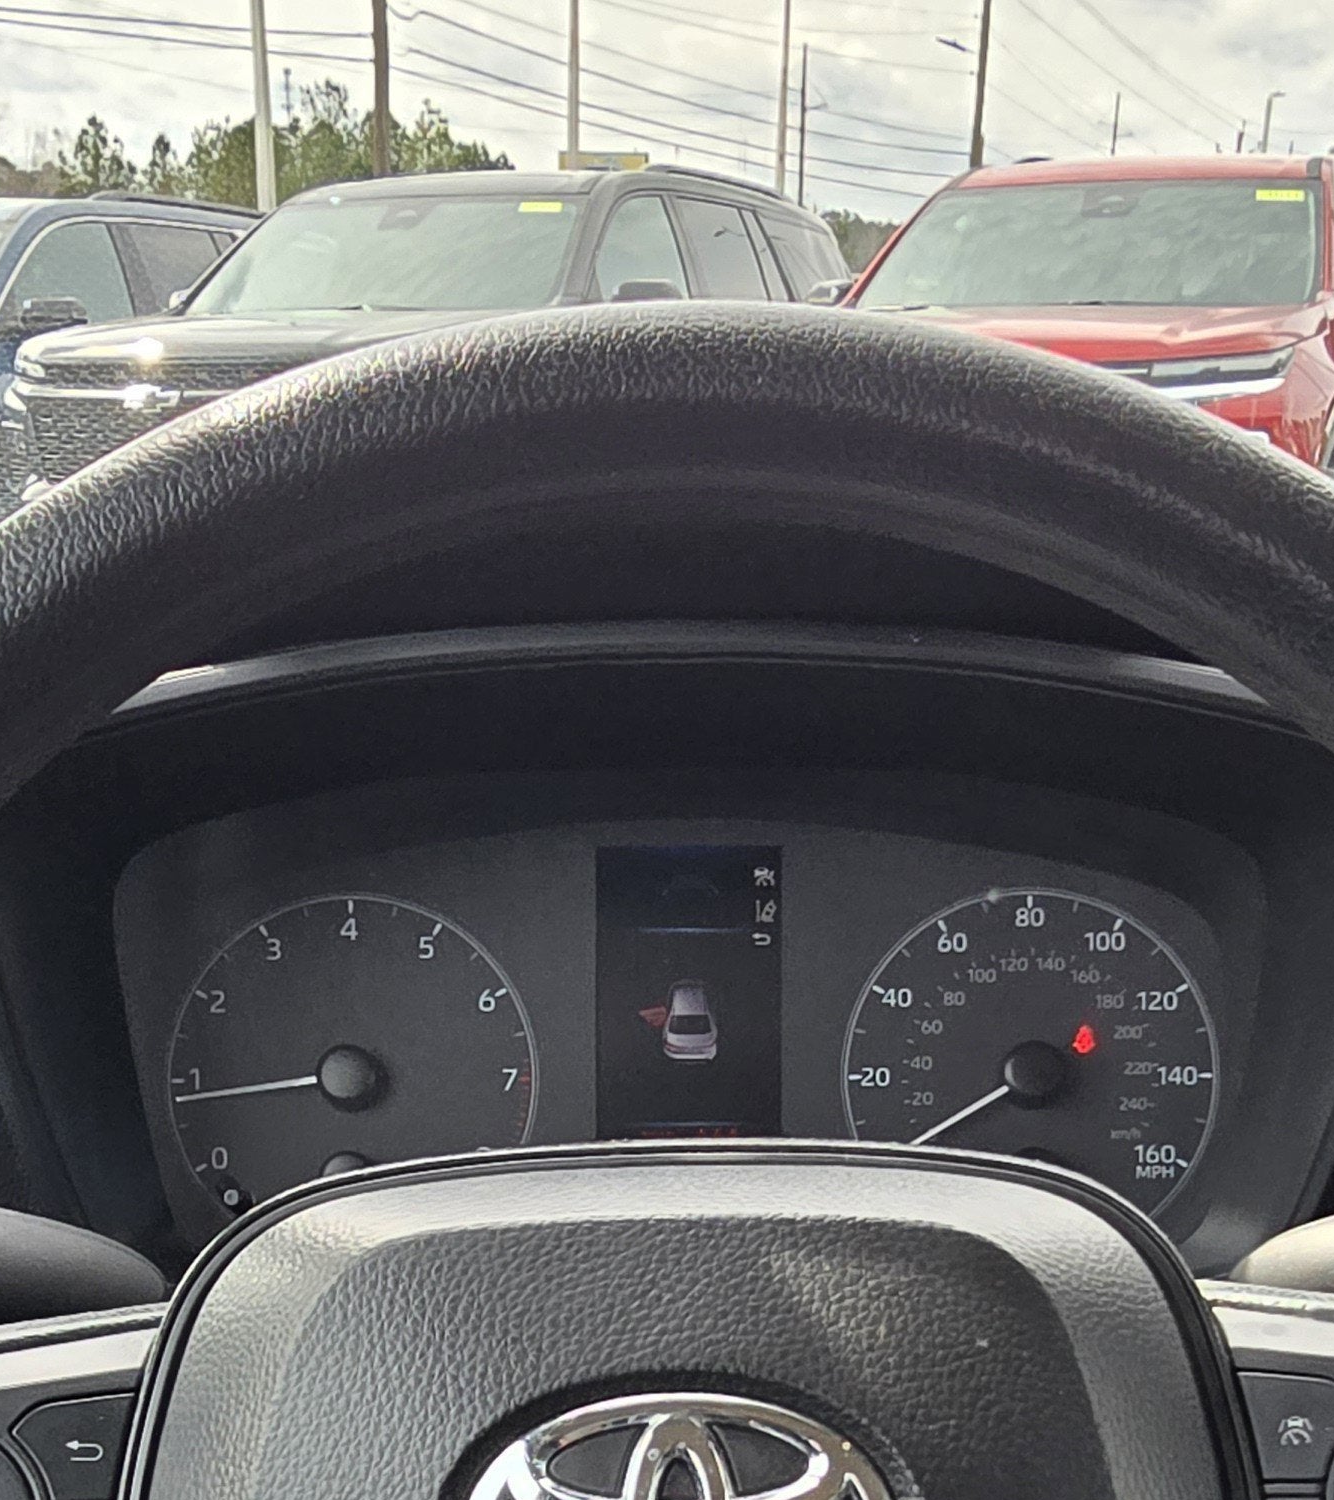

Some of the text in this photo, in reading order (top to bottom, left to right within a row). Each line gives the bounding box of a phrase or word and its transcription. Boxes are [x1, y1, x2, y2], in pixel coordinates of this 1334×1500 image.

[1015, 907, 1045, 927] 80
[340, 917, 358, 941] 4
[266, 938, 282, 961] 3
[418, 936, 435, 959] 5
[937, 932, 968, 953] 60
[1084, 931, 1126, 951] 100
[999, 957, 1029, 972] 120
[1036, 957, 1066, 972] 140
[967, 968, 997, 983] 100
[1070, 969, 1100, 984] 160
[210, 990, 226, 1014] 2
[478, 988, 496, 1012] 6
[881, 988, 912, 1008] 40
[943, 991, 966, 1006] 80
[1095, 994, 1124, 1009] 180
[1136, 991, 1179, 1011] 120
[921, 1020, 943, 1034] 60
[910, 1055, 933, 1070] 40
[189, 1068, 200, 1090] 1
[502, 1068, 518, 1091] 7
[860, 1067, 890, 1087] 20
[1156, 1065, 1199, 1086] 140
[912, 1091, 934, 1106] 20
[1119, 1097, 1147, 1111] 240
[211, 1146, 228, 1170] 0
[1134, 1143, 1176, 1164] 160
[1135, 1165, 1175, 1179] MPH
